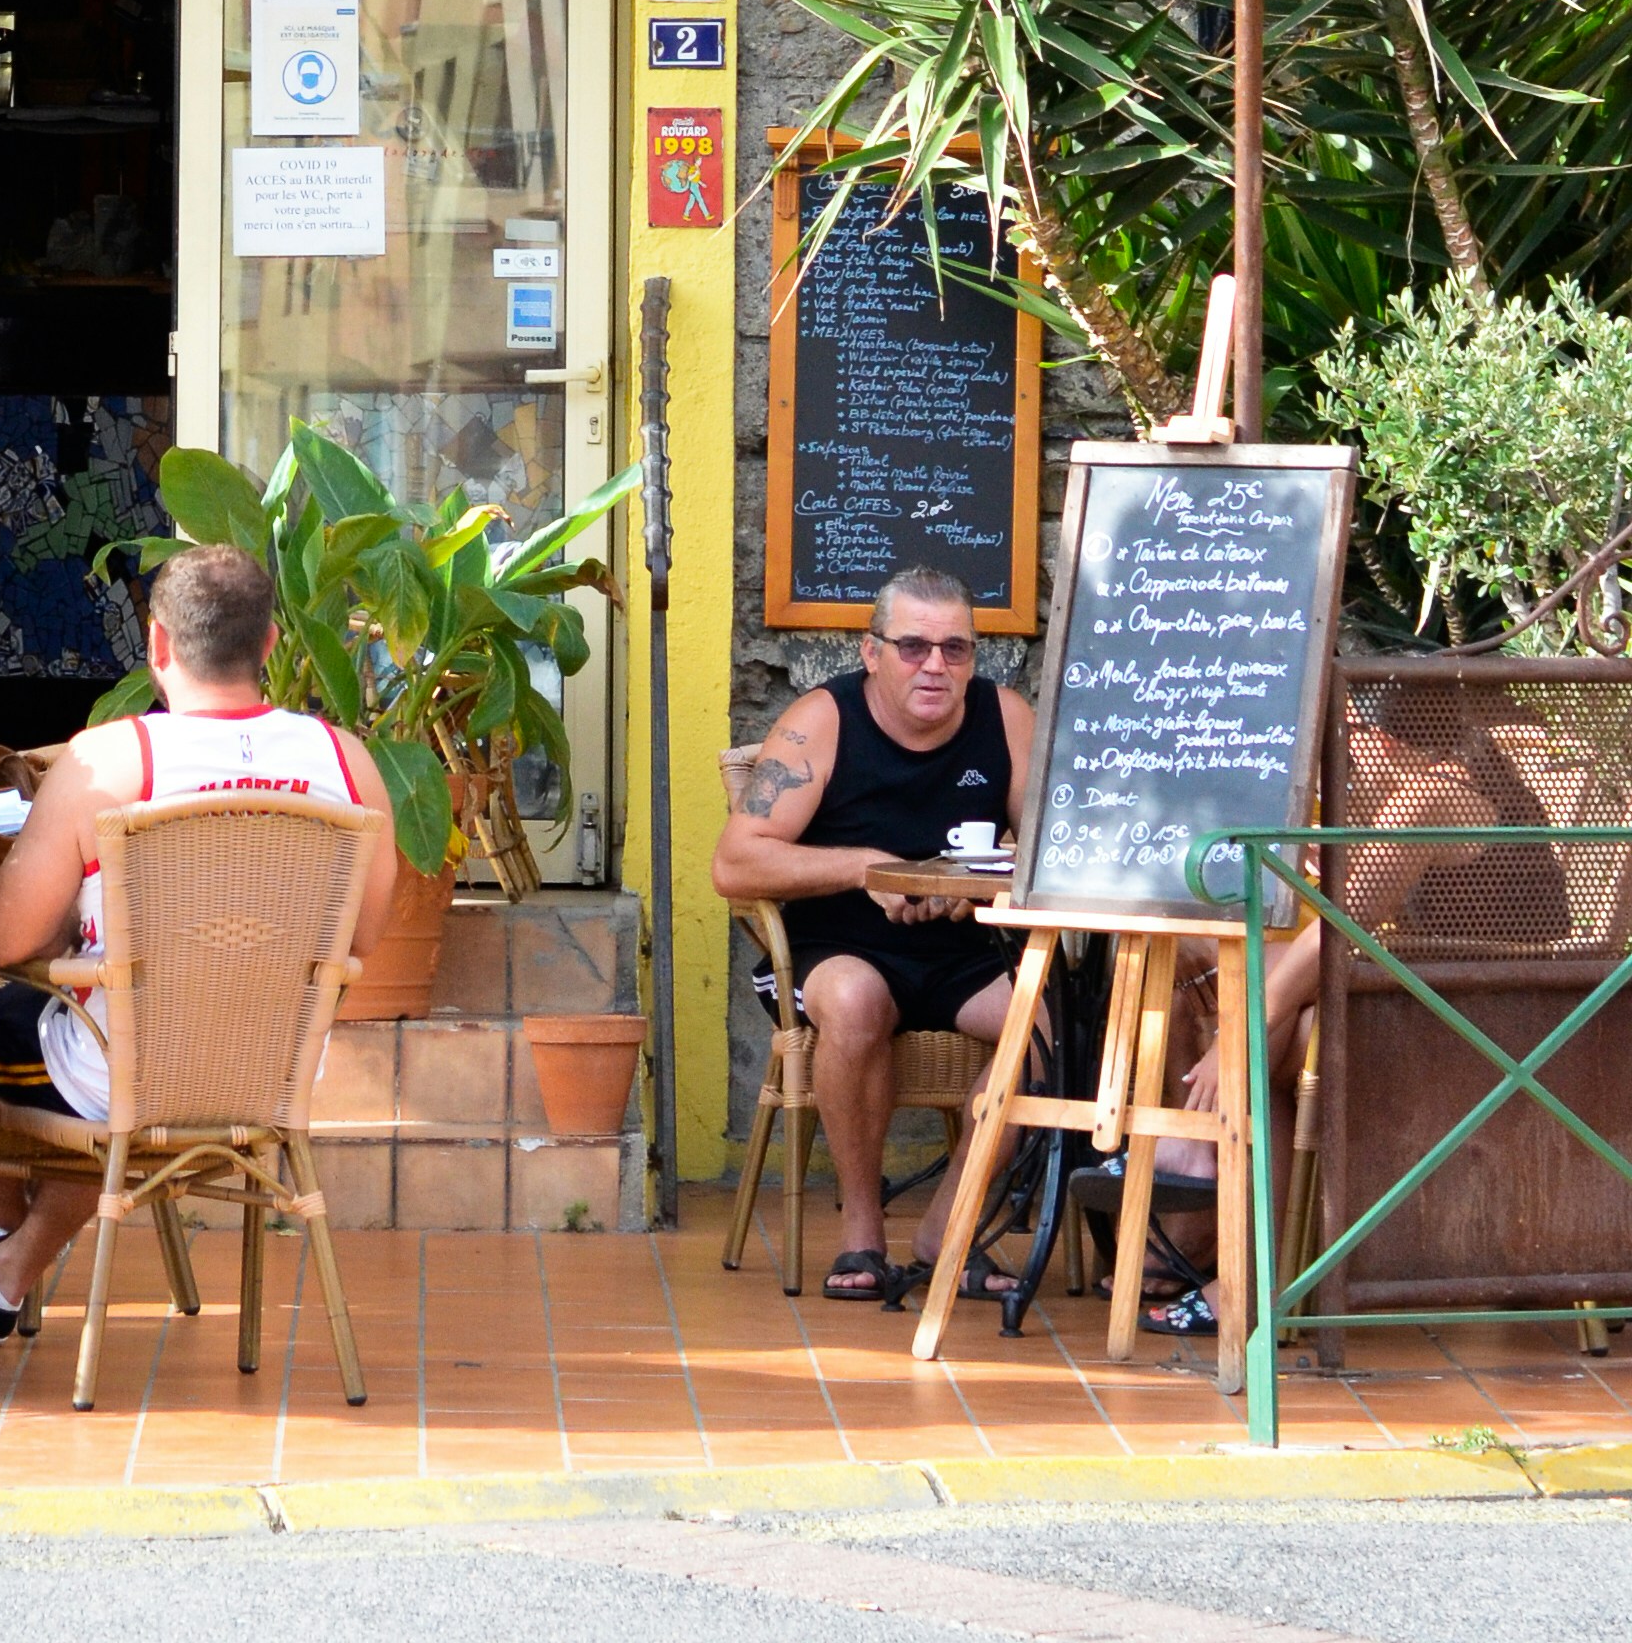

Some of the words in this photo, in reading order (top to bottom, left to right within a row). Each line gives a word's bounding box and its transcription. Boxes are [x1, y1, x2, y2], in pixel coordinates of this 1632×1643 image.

[676, 26, 698, 60] 2
[661, 126, 708, 137] ROUTARD
[654, 137, 714, 156] 1998
[280, 160, 320, 170] COVID
[326, 160, 337, 170] 19
[245, 175, 286, 186] ACCES
[306, 175, 331, 184] BAR
[335, 174, 372, 184] interdit
[255, 192, 279, 202] pour
[282, 190, 296, 200] les
[301, 190, 323, 200] WC,
[326, 191, 353, 202] porte
[356, 189, 363, 199] à
[274, 206, 300, 215] votre
[304, 205, 341, 217] gauche
[244, 220, 273, 230] merci
[276, 220, 293, 231] (on
[297, 220, 316, 229] s'en
[511, 333, 552, 343] Poussez
[812, 327, 885, 340] MELANGES
[848, 364, 879, 377] Label
[1208, 480, 1263, 510] 25€
[844, 497, 891, 511] CAFES
[825, 520, 879, 534] Ethiopie
